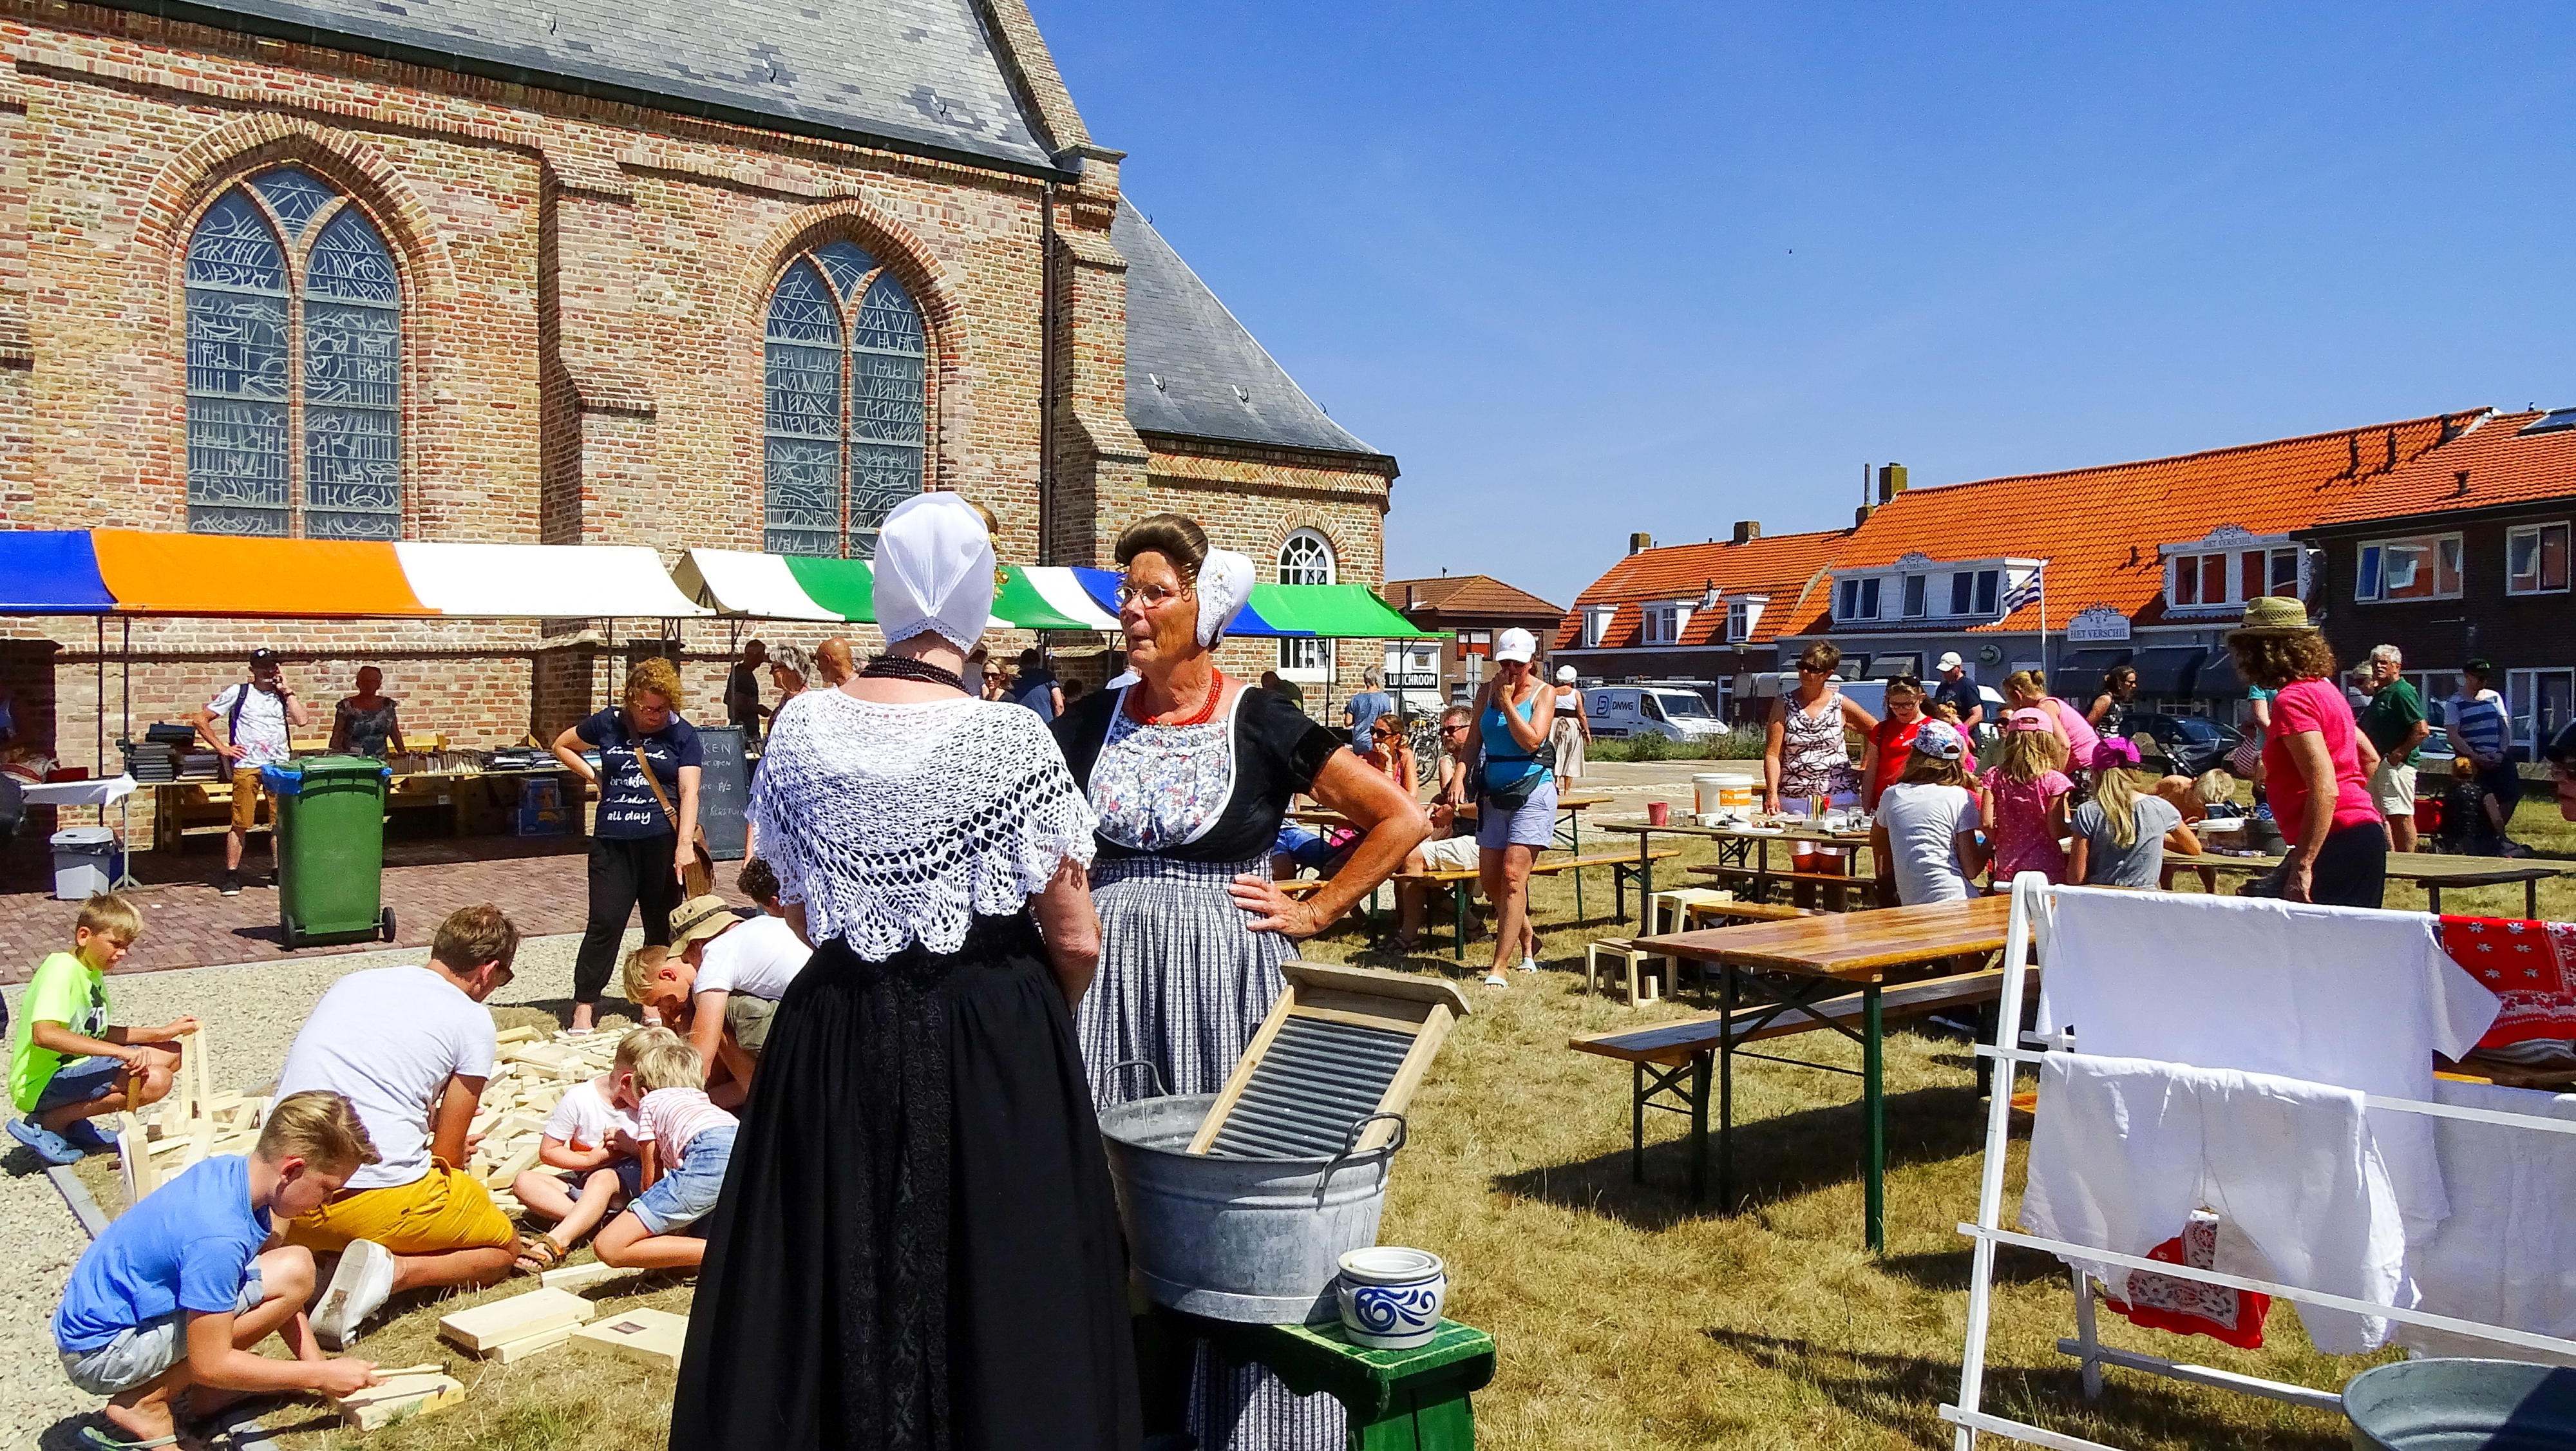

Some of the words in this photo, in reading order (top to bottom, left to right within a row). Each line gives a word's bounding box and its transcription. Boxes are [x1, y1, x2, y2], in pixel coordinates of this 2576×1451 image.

[2070, 629, 2086, 638] HET
[2087, 628, 2128, 638] VERSCHIL
[1388, 674, 1435, 686] LUNCHROOM
[1612, 701, 1634, 710] DNWG
[701, 737, 731, 755] KEN
[606, 746, 668, 760] diamnds
[713, 759, 731, 768] OPEN
[610, 772, 650, 788] breakfa
[607, 810, 622, 821] all
[624, 810, 651, 825] day
